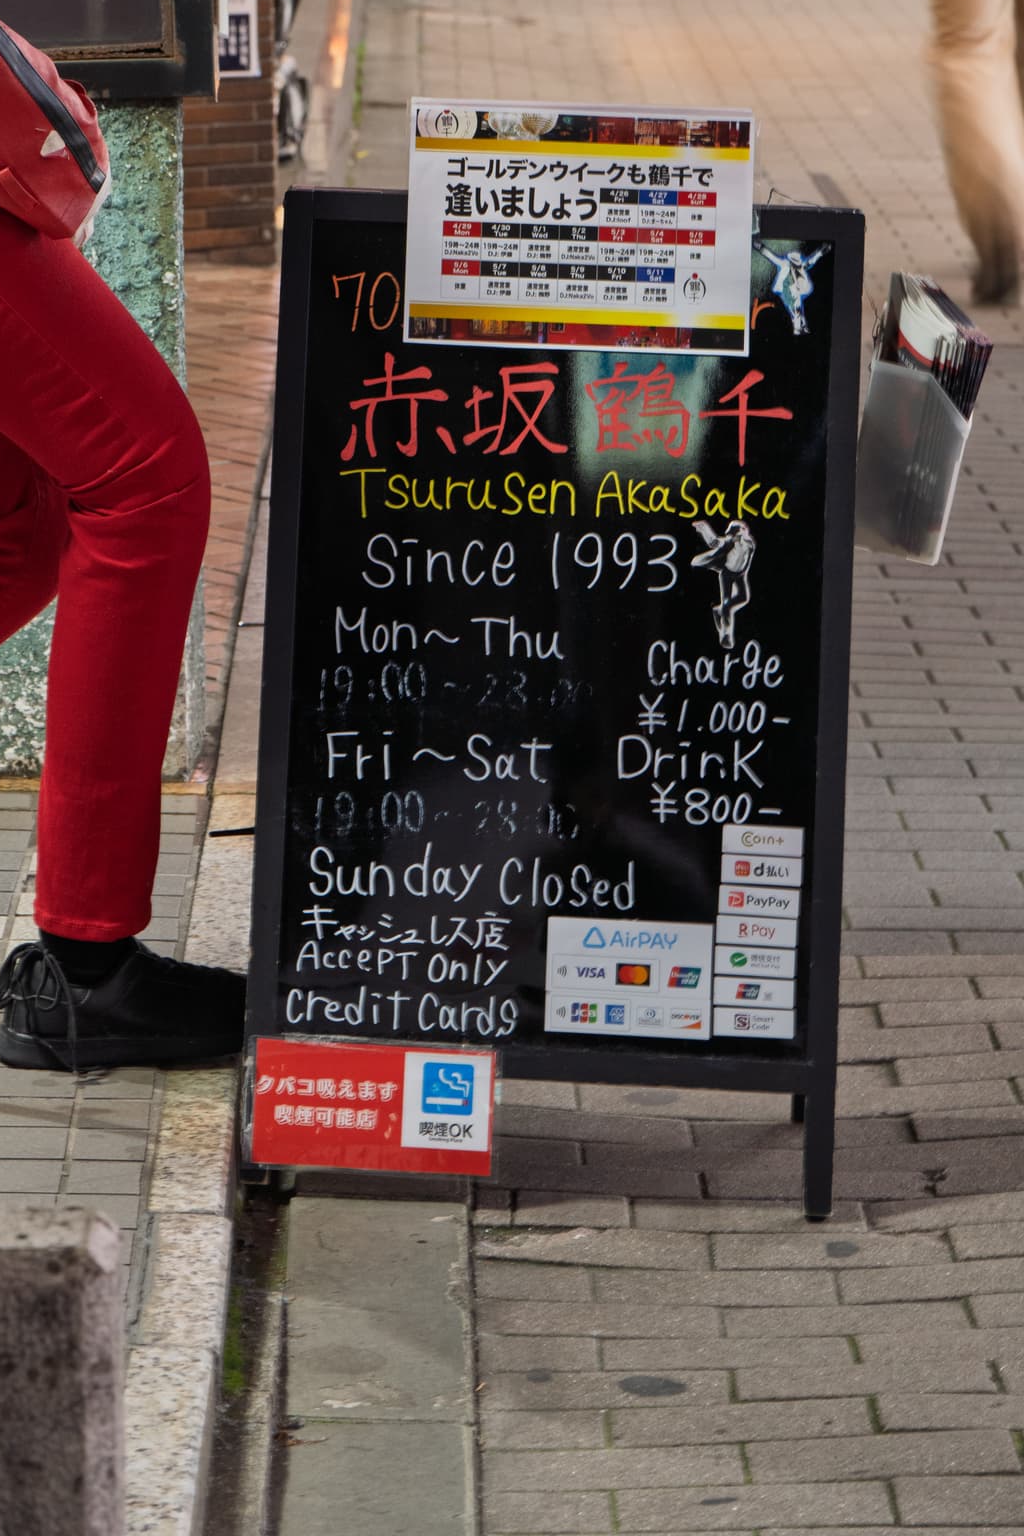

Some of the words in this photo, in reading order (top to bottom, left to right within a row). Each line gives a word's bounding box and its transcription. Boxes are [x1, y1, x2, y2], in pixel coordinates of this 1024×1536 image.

[447, 157, 713, 187] ゴールデンウイークも鶴千で
[445, 183, 598, 222] 逢いましょう
[340, 352, 793, 466] 赤坂鶴千
[361, 533, 516, 588] Since
[551, 531, 678, 591] 1993
[647, 640, 784, 690] Charge
[309, 842, 483, 902] Sunday
[499, 857, 636, 911] Closed
[746, 895, 790, 910] PayPay
[300, 904, 512, 951] キャッシュレス店
[609, 930, 679, 950] AirPAY
[428, 953, 508, 986] Only
[575, 966, 606, 979] VISA
[286, 986, 411, 1030] Credit
[418, 993, 519, 1038] Cards
[274, 1105, 378, 1130] 喫煙可能店
[419, 1121, 474, 1139] 喫煙OK
